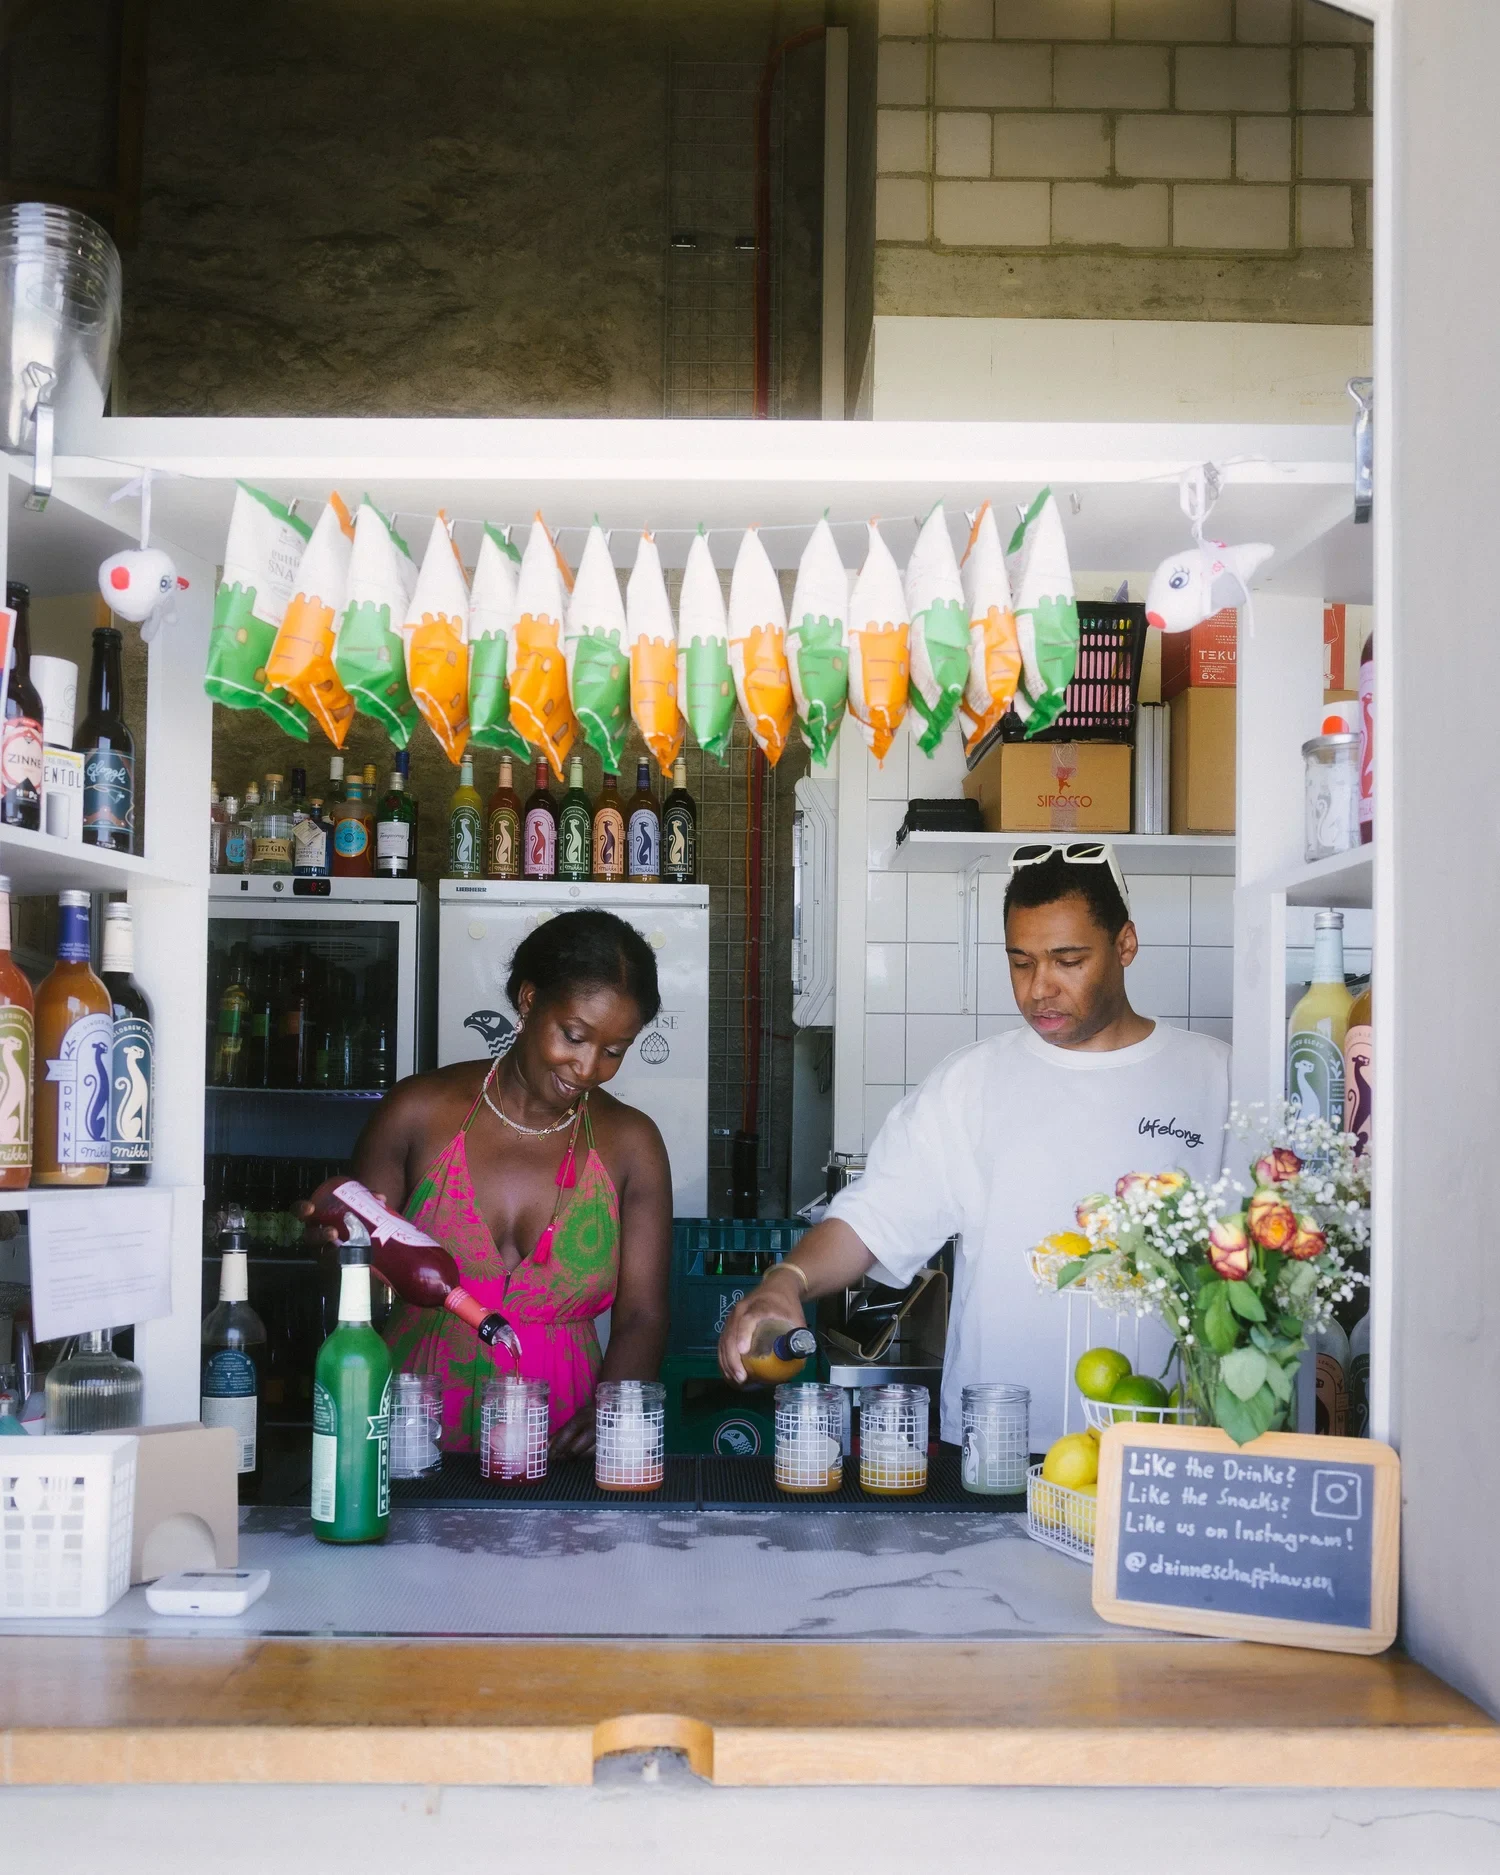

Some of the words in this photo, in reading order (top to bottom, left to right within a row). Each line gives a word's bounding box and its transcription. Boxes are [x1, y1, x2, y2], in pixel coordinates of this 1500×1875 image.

[1199, 650, 1236, 661] TEKU
[44, 766, 82, 789] ENTOL
[1037, 795, 1093, 808] SIROCCO
[112, 1025, 141, 1038] OLDBREW
[63, 1085, 73, 1158] DRINK
[1185, 1456, 1215, 1480] the
[1127, 1481, 1171, 1506] Like
[1181, 1486, 1207, 1506] the
[1125, 1511, 1166, 1534] Like
[1176, 1522, 1196, 1536] us
[1205, 1526, 1228, 1540] on
